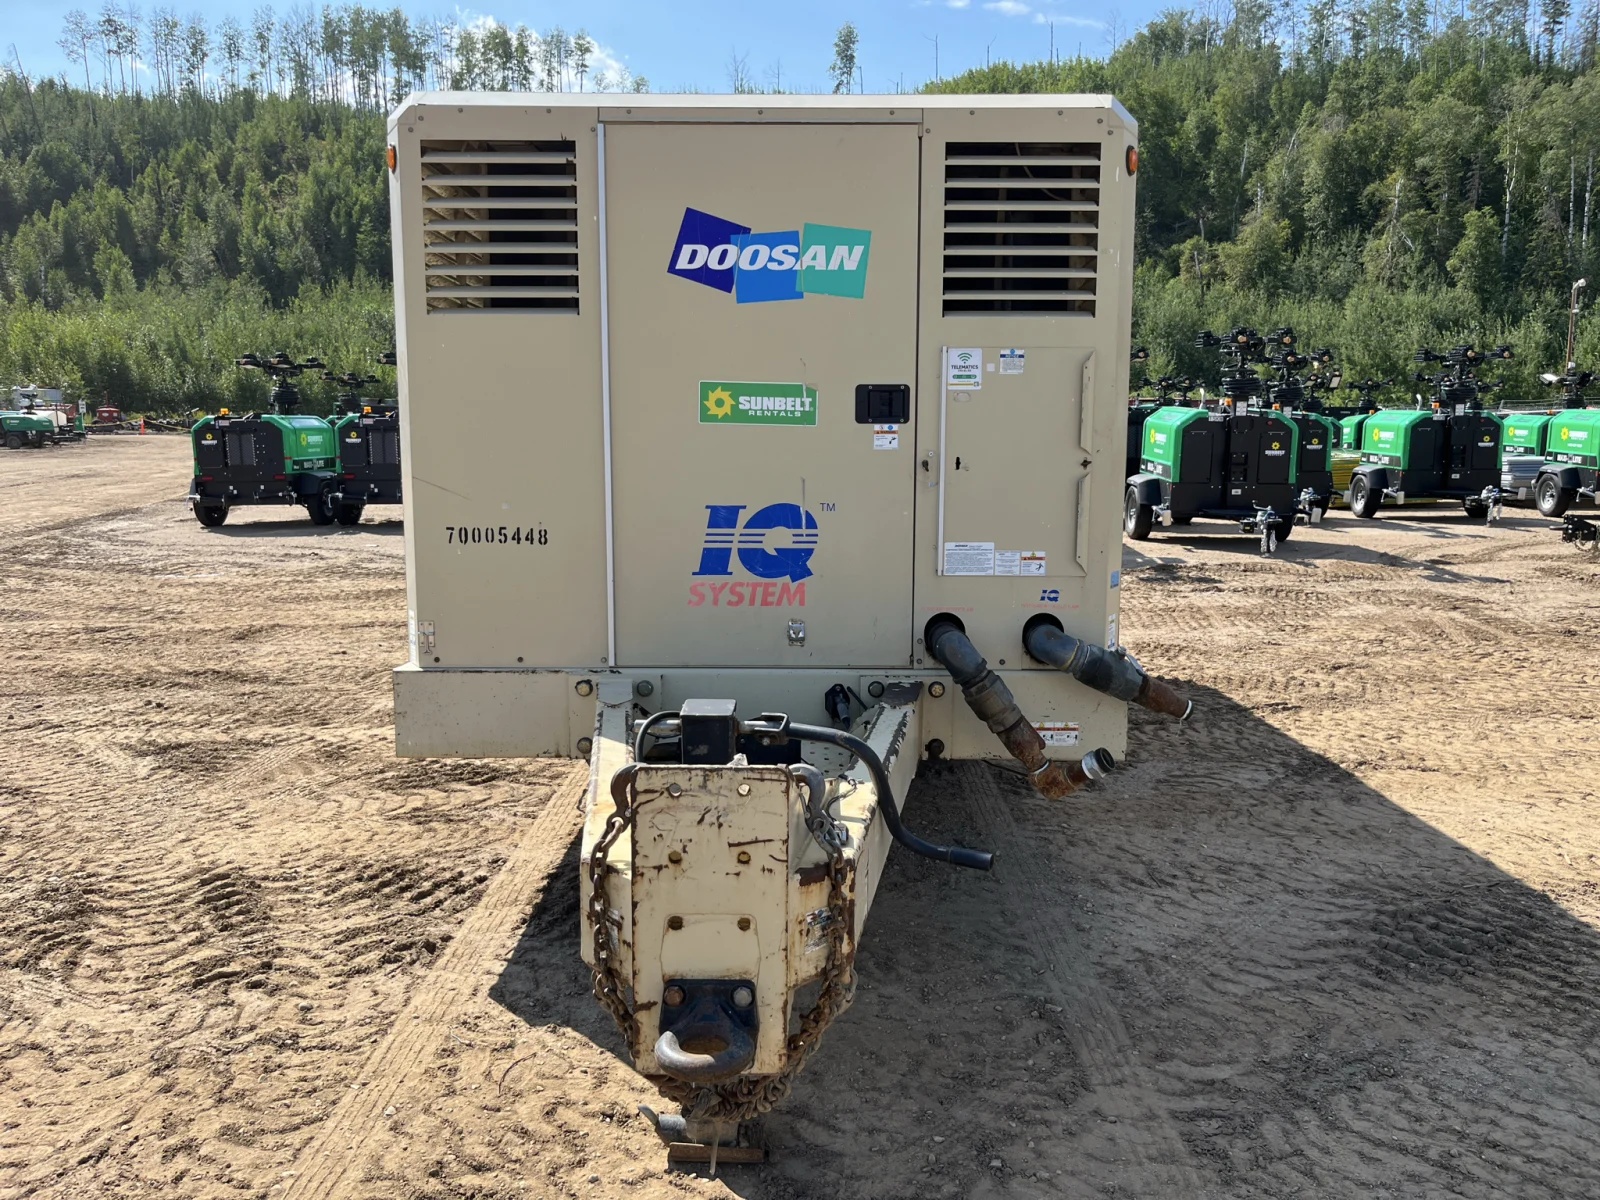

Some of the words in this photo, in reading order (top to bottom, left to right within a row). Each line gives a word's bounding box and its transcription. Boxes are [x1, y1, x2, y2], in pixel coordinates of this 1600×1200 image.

[675, 244, 865, 271] DOOSAN
[738, 395, 812, 412] SUNBELT
[446, 527, 548, 545] 70005448
[692, 503, 818, 583] IQ
[820, 502, 836, 512] TM
[687, 581, 806, 607] SYSTEM
[1039, 589, 1060, 602] IQ
